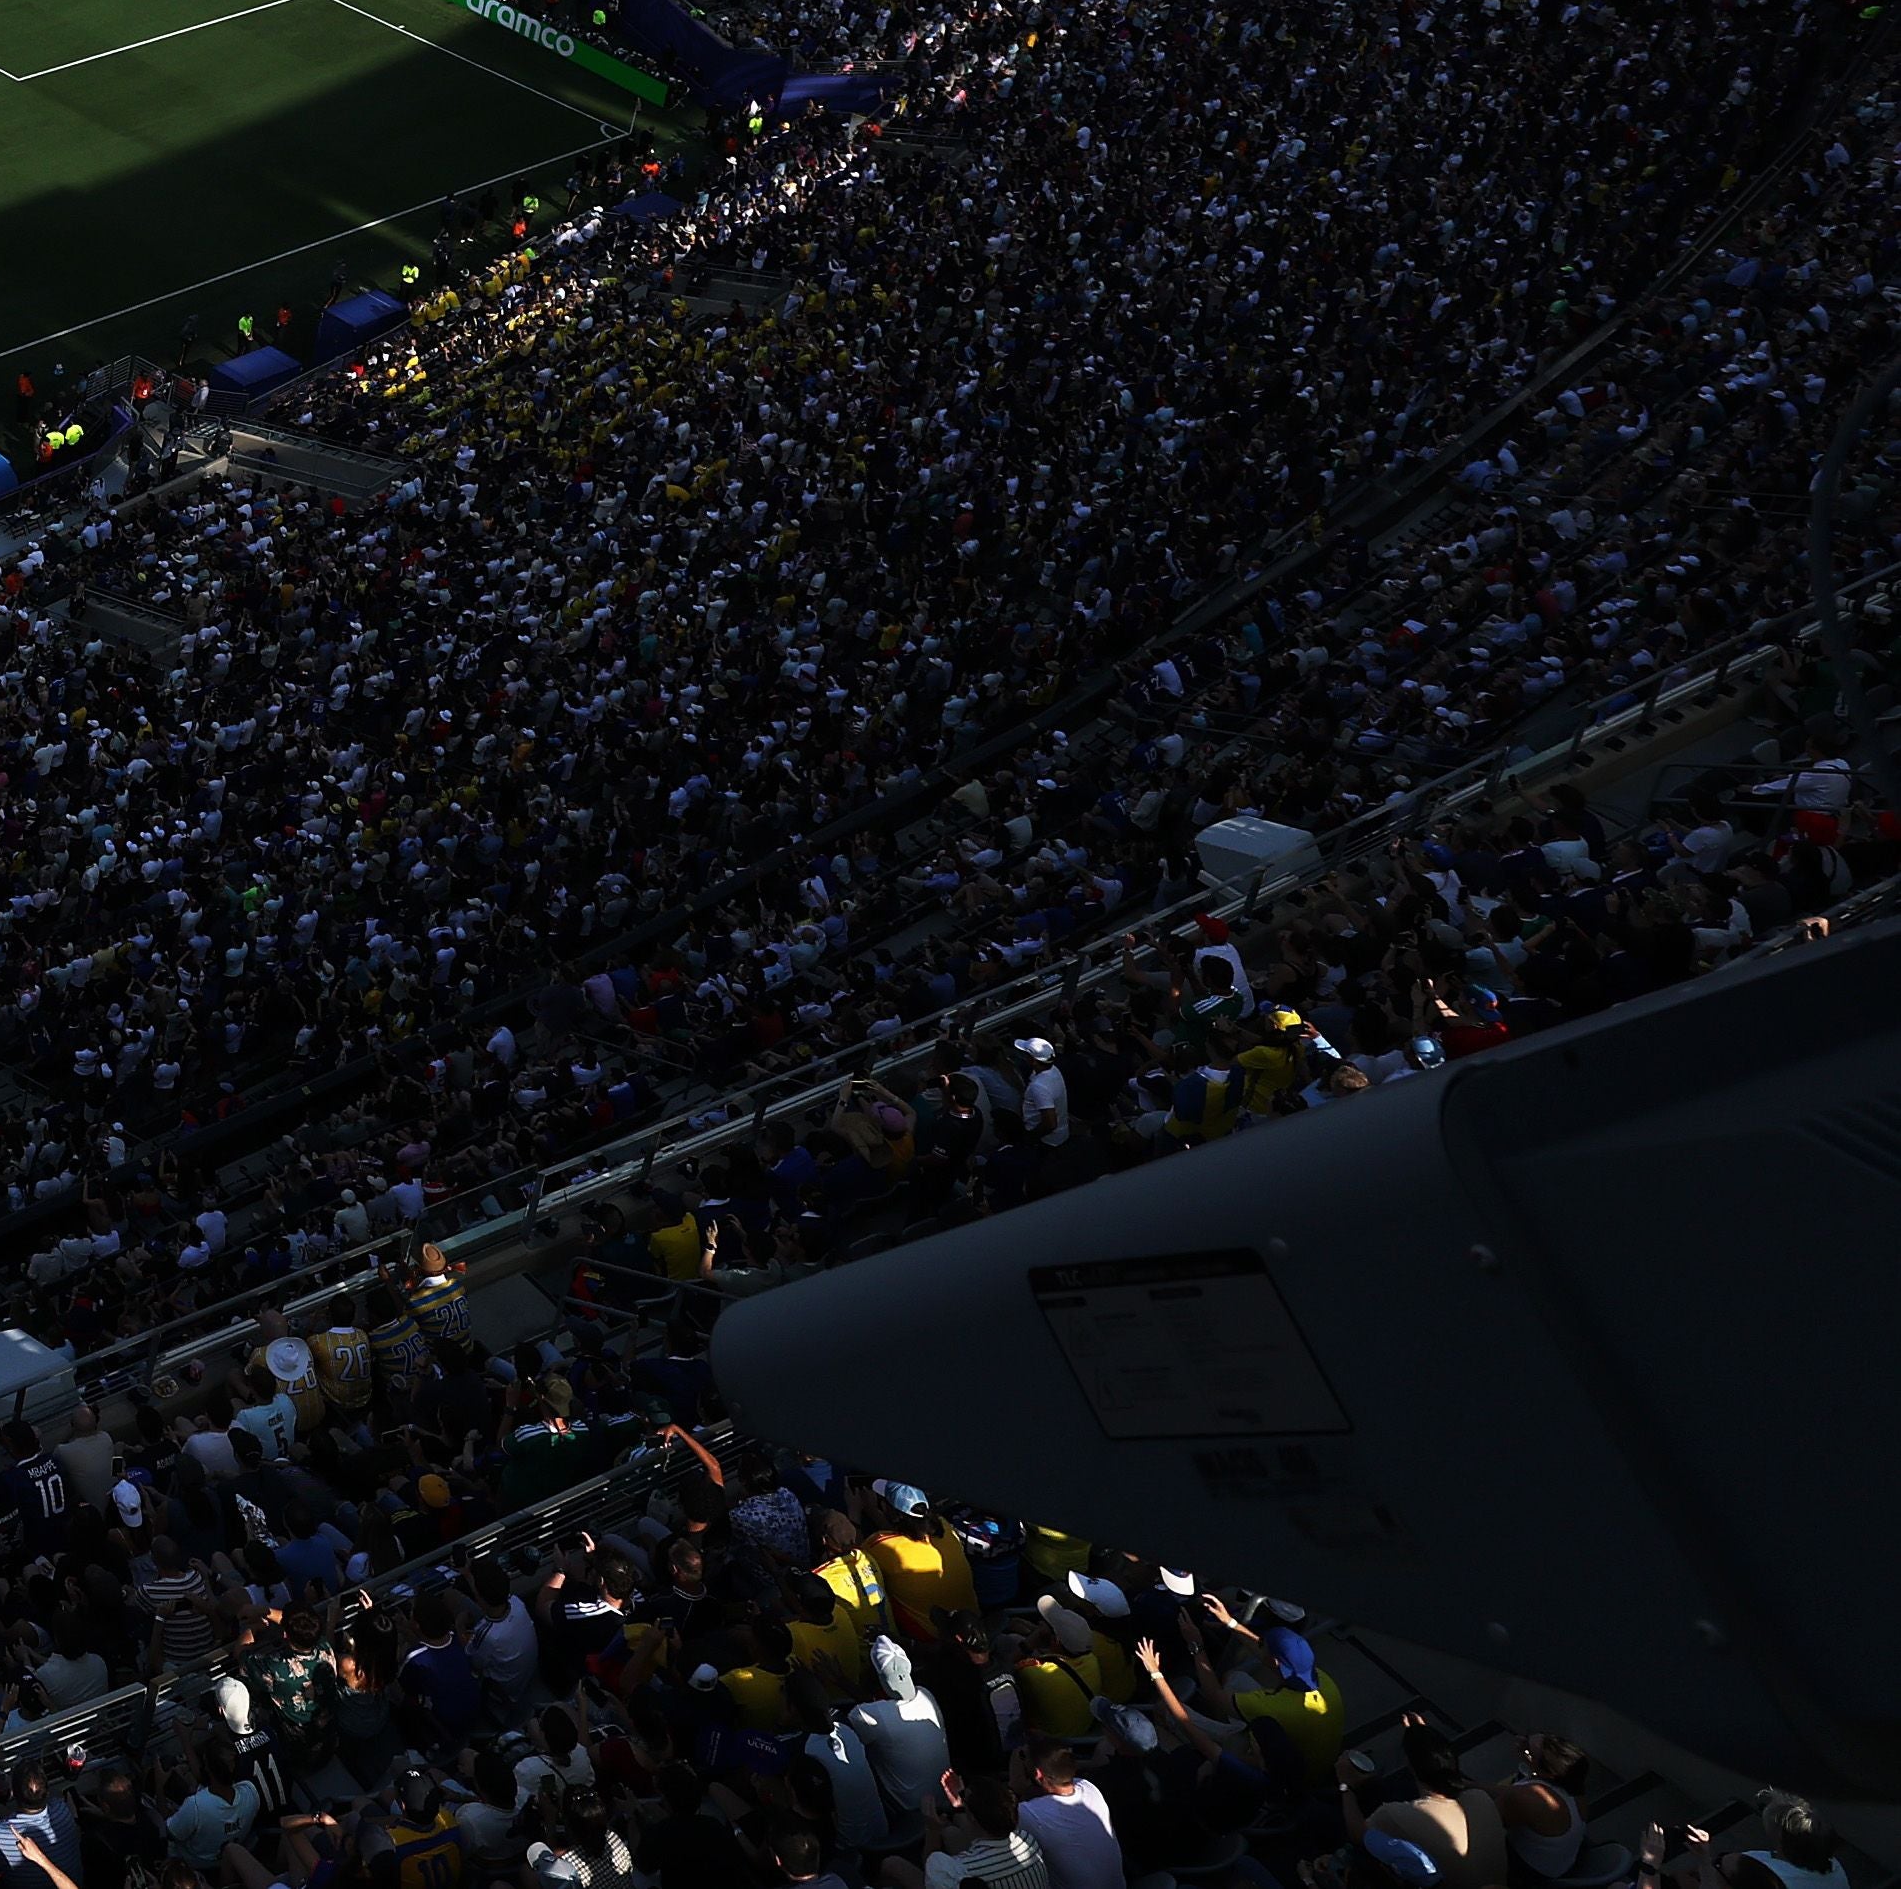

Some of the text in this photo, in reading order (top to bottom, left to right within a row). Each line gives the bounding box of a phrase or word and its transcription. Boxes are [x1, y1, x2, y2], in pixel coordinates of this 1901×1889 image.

[439, 1302, 468, 1338] 26
[335, 1343, 370, 1383] 26
[274, 1426, 289, 1457] 5
[32, 1473, 67, 1518] 10
[746, 1738, 779, 1755] ULTRA
[251, 1760, 288, 1809] 11
